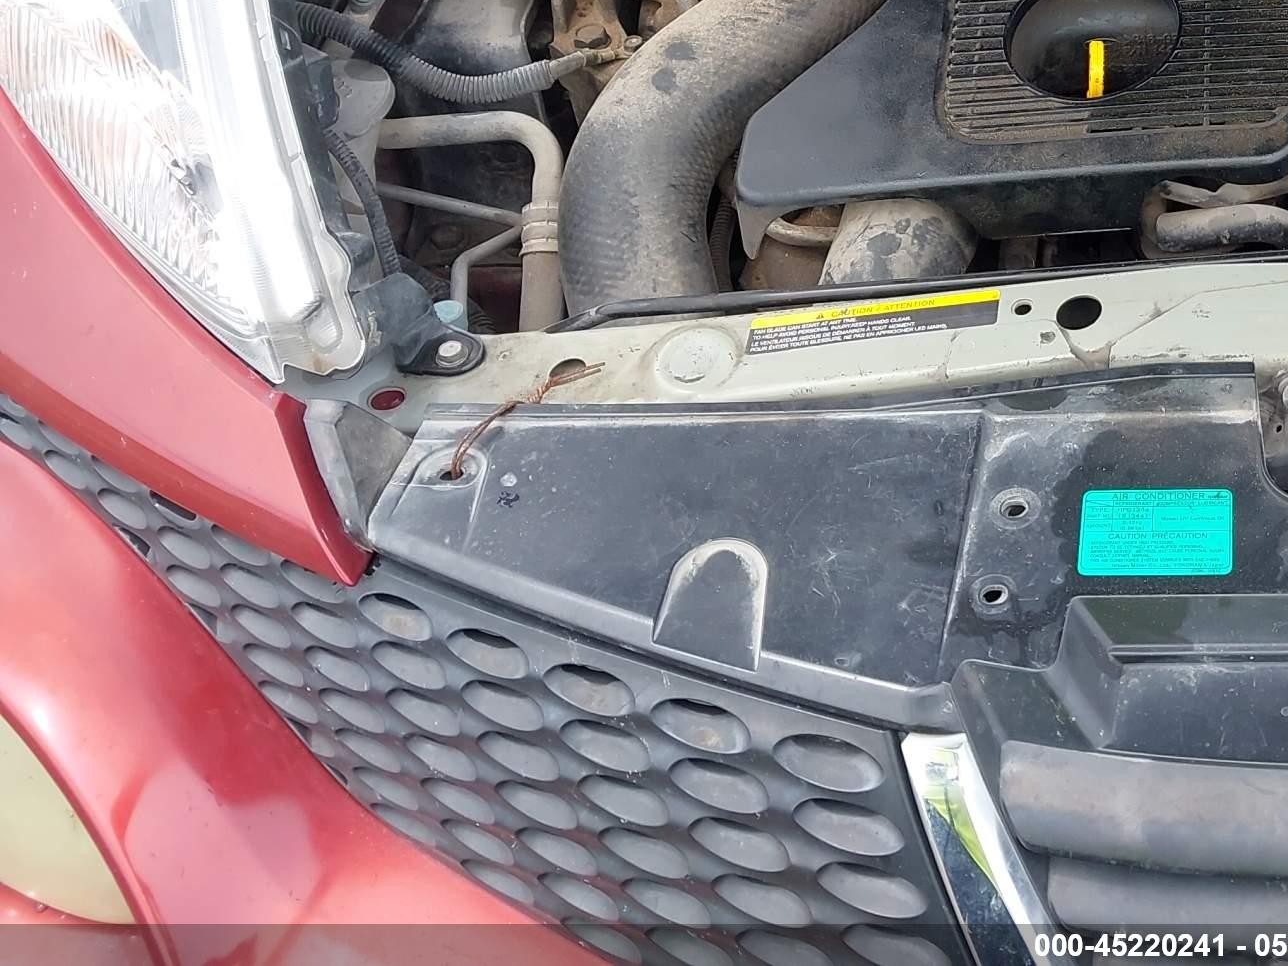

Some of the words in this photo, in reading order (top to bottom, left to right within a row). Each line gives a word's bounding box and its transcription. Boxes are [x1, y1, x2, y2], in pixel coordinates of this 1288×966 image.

[831, 306, 873, 318] CAUTION
[884, 299, 935, 311] ATTENTION
[1112, 492, 1129, 500] AIR
[1136, 492, 1205, 500] CONDITIONER
